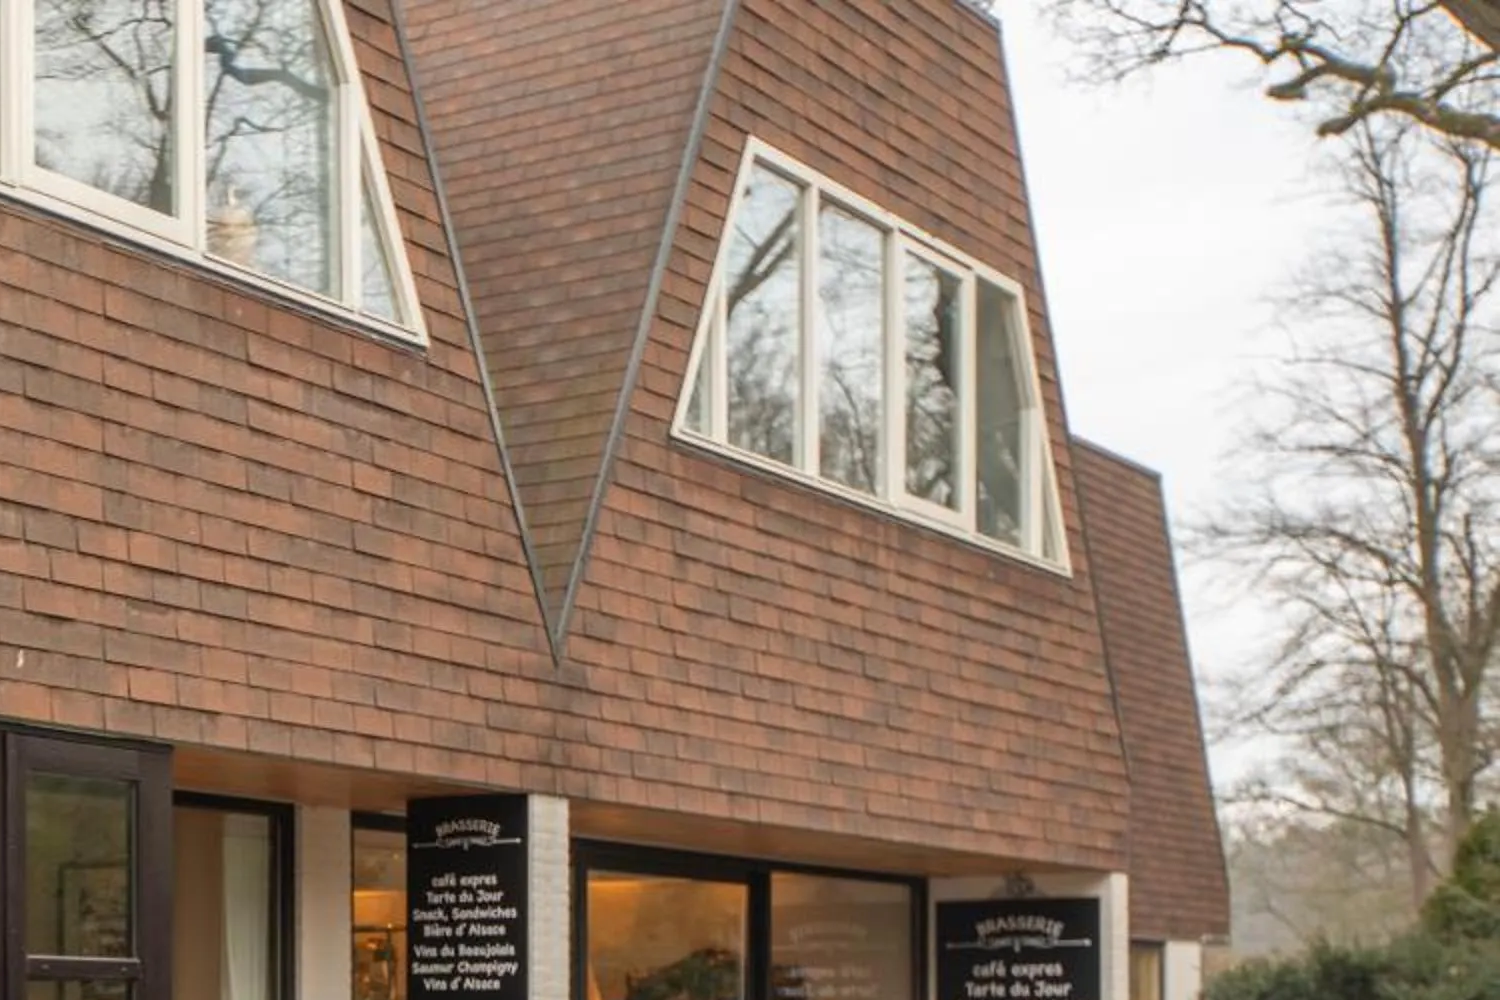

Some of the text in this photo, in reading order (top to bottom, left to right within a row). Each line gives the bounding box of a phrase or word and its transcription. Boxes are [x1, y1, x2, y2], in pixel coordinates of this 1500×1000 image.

[476, 889, 504, 903] Jour
[451, 906, 517, 920] Sandwiches
[468, 924, 506, 937] Alsace
[975, 915, 1065, 938] BRASSERIE
[972, 960, 1063, 981] café expres
[965, 980, 1073, 998] Tarte du Jour
